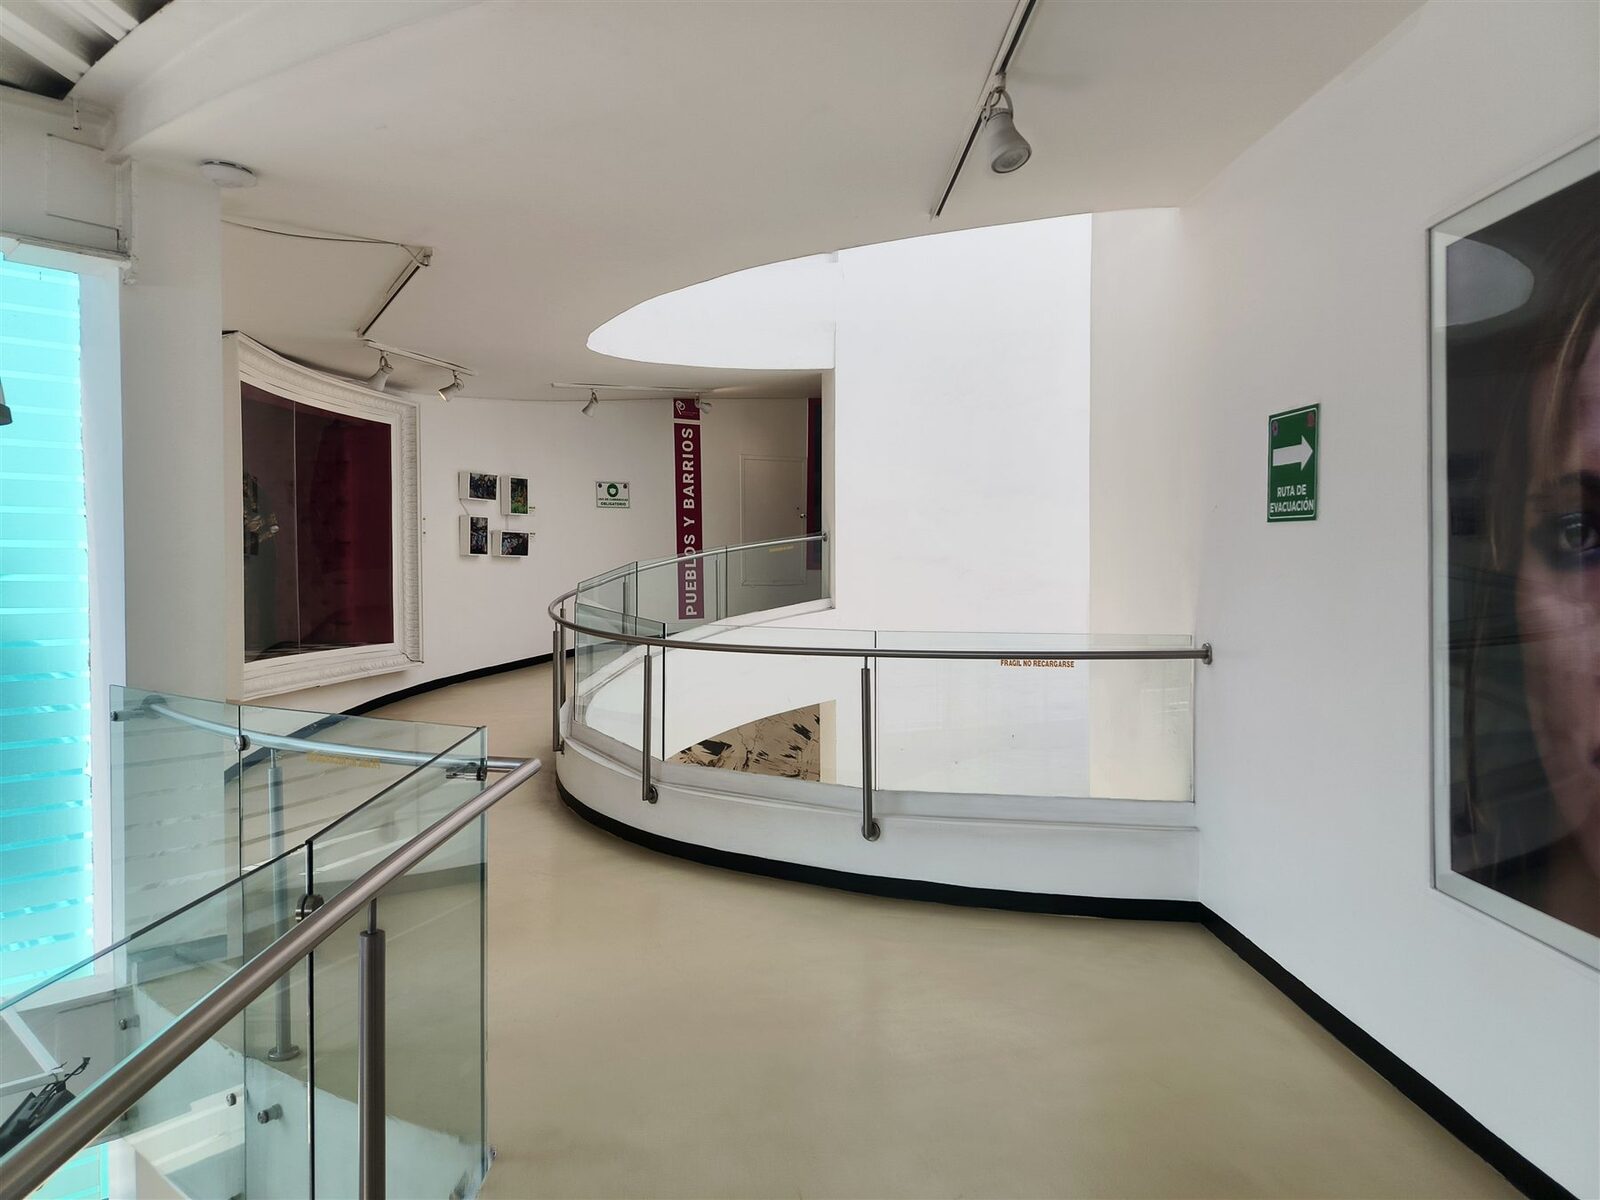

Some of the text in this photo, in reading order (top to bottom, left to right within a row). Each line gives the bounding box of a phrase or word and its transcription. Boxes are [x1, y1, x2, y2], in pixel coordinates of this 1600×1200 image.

[681, 427, 695, 509] BARRIOS
[1277, 484, 1307, 498] RUTA DE
[1270, 497, 1314, 513] EVACUACIÓN
[683, 516, 695, 527] Y
[683, 534, 698, 616] PUEBLOS
[1000, 659, 1022, 667] FRAGIL
[1032, 660, 1075, 668] RECARGARSE
